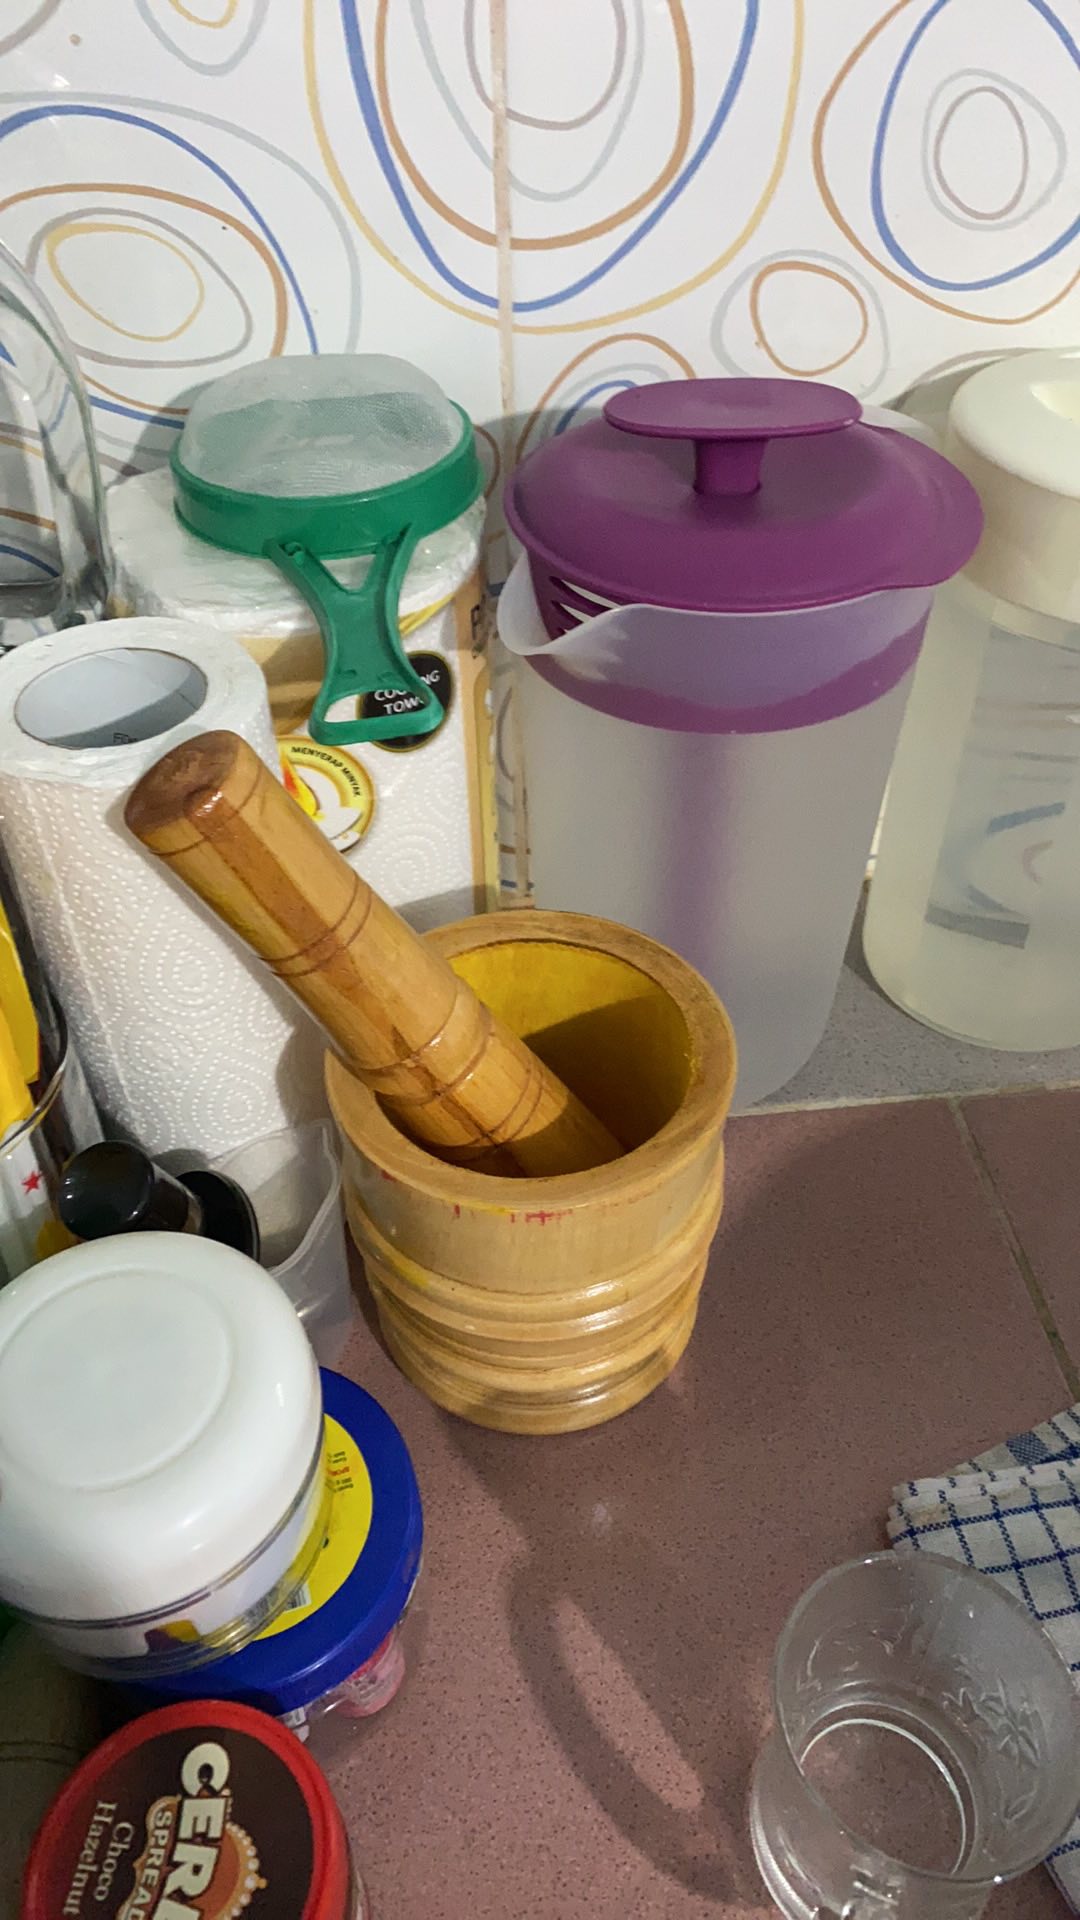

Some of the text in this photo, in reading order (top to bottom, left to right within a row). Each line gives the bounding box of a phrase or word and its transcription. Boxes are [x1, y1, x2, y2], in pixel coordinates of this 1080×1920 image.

[291, 746, 361, 797] MENYERAP MINYAK
[63, 1801, 117, 1915] Hazelnut
[94, 1822, 134, 1901] Choco
